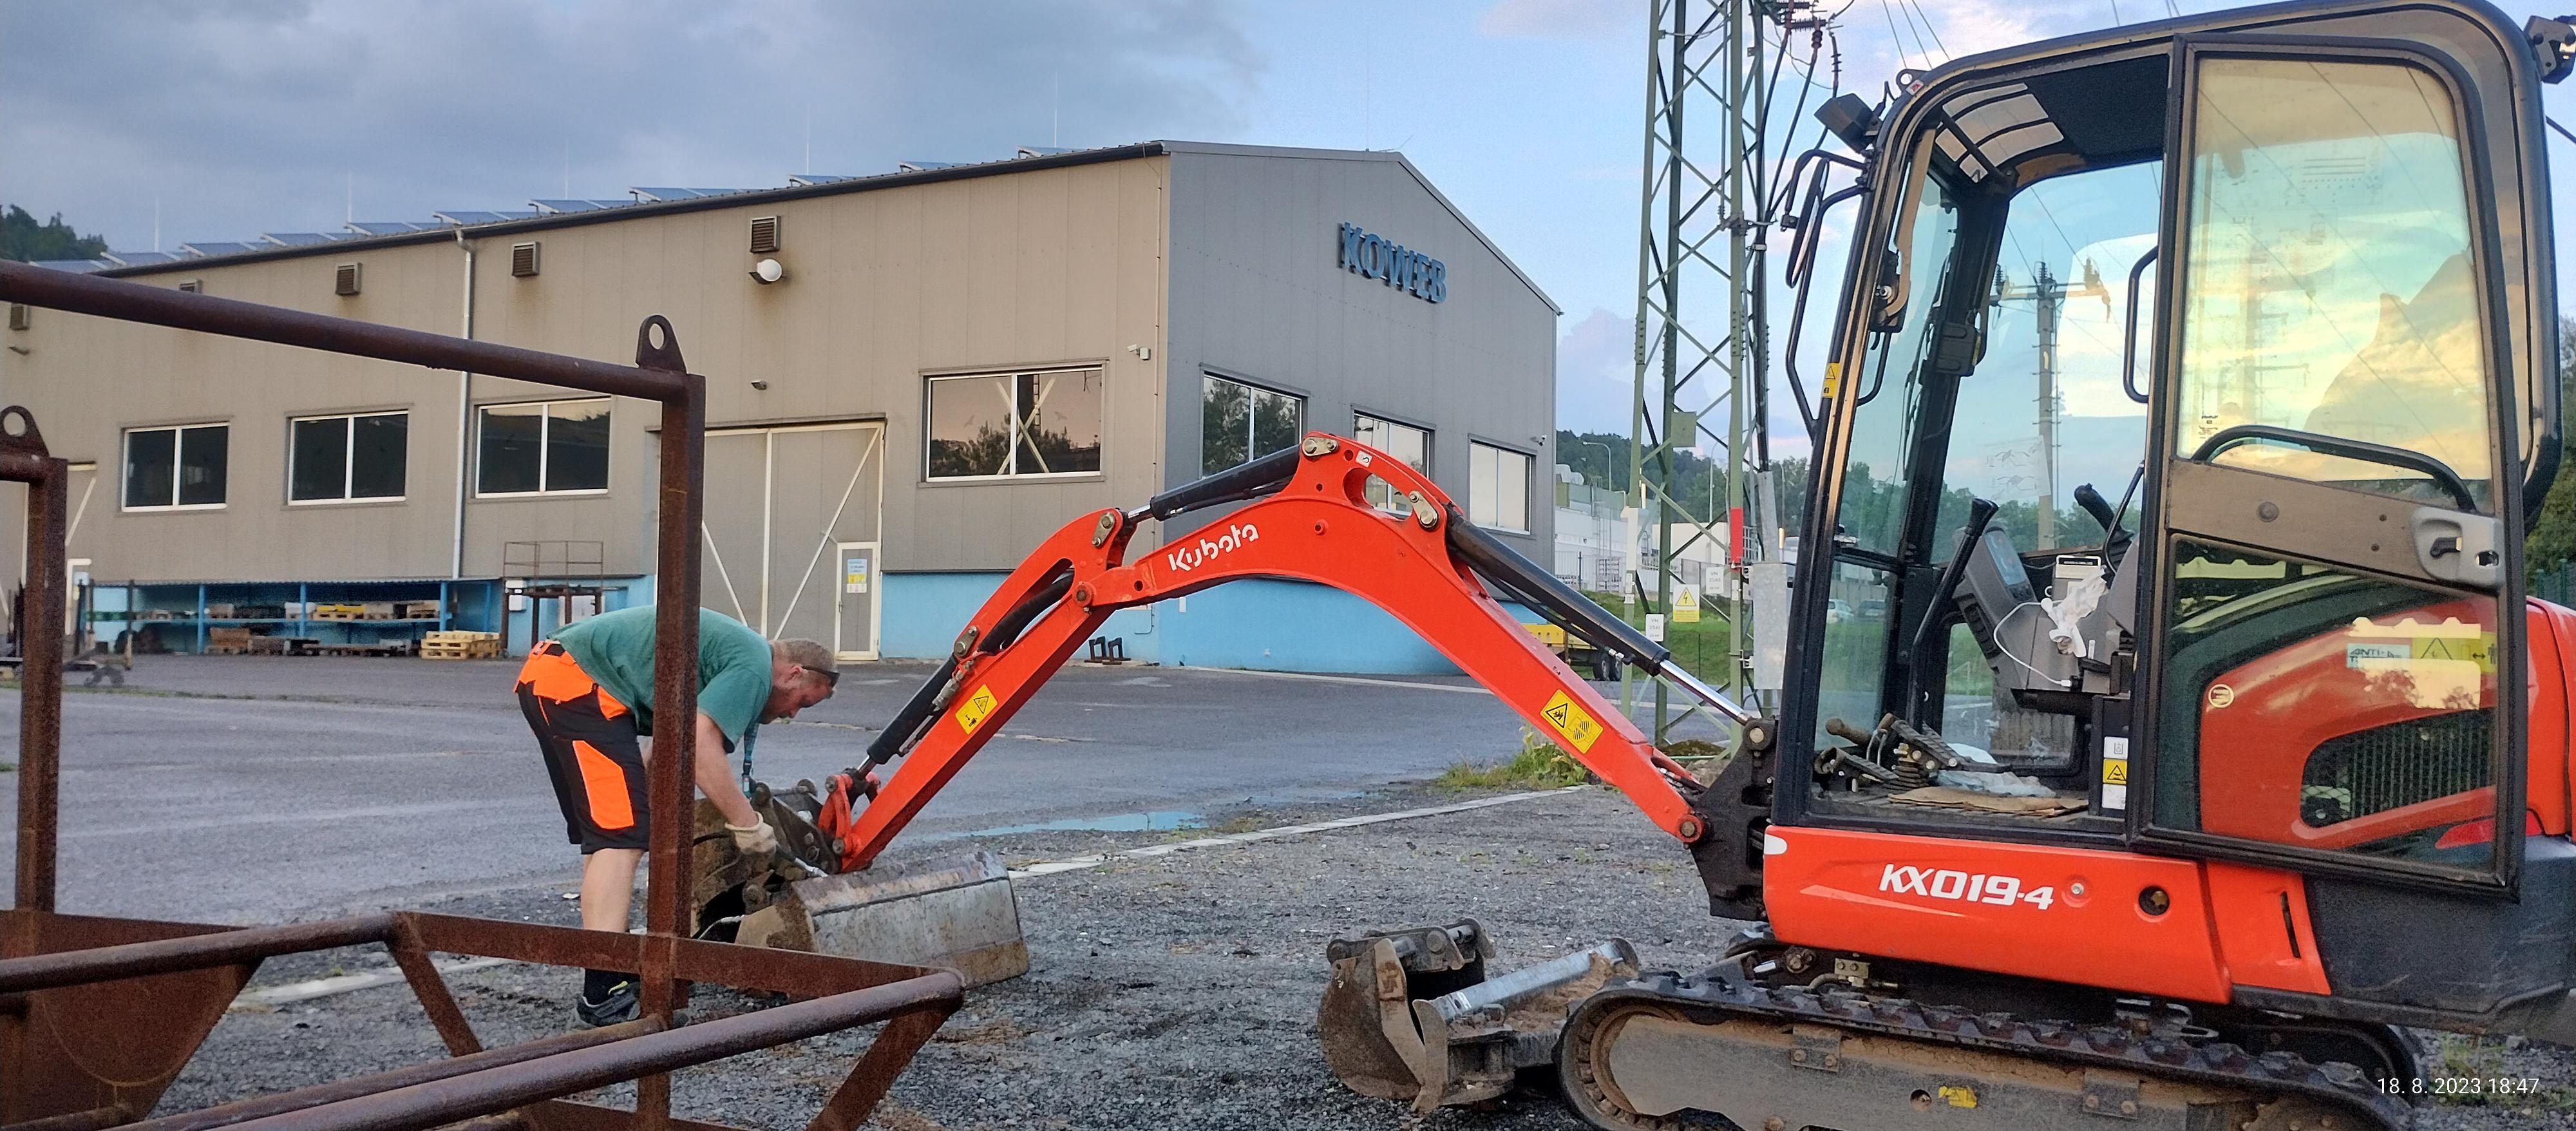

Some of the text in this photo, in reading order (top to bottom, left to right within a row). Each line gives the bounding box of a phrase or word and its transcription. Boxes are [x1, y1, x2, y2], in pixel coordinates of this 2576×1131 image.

[1343, 222, 1446, 304] KOWEB
[1167, 523, 1260, 572] Kubota
[1878, 863, 2055, 911] KX019-4
